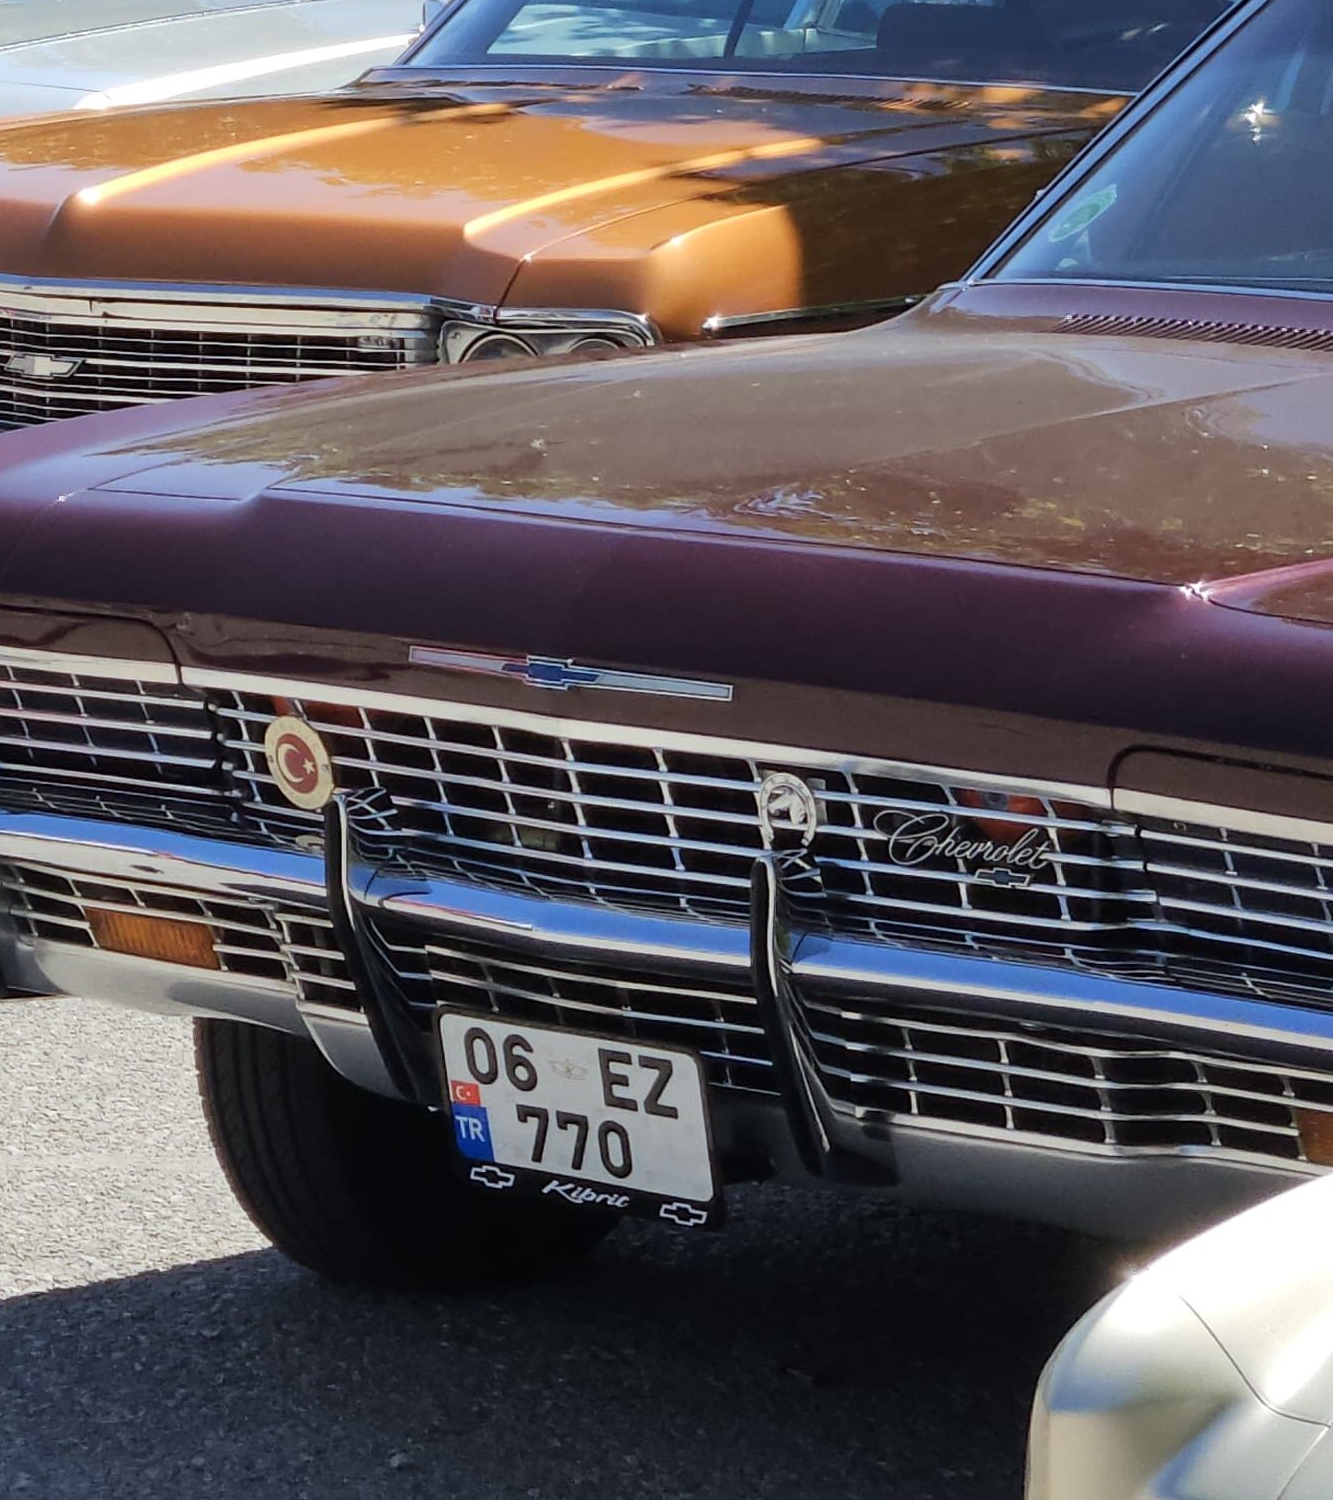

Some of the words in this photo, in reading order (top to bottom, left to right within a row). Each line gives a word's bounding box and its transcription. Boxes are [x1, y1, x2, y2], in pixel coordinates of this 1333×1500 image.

[873, 809, 1054, 870] Chevrolet
[464, 1026, 538, 1092] 06
[597, 1047, 679, 1119] EZ
[455, 1115, 486, 1142] TR
[516, 1103, 633, 1179] 770
